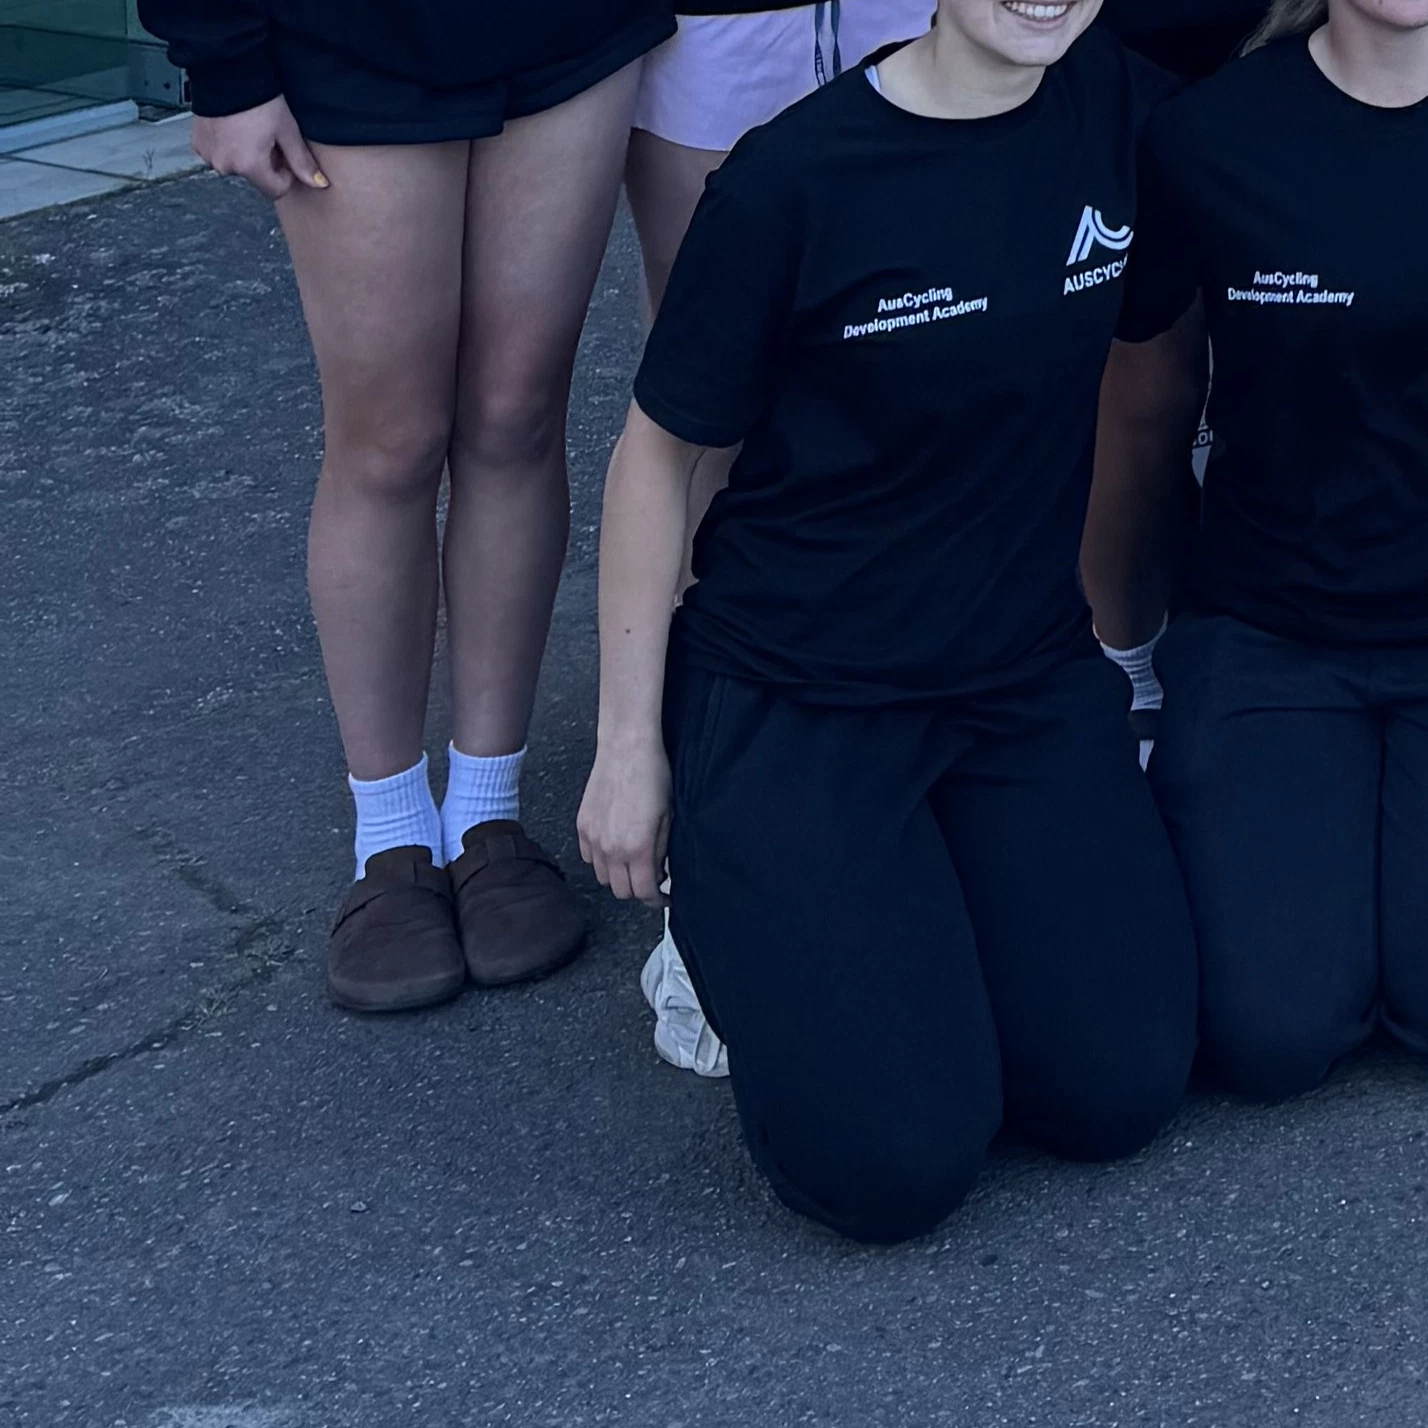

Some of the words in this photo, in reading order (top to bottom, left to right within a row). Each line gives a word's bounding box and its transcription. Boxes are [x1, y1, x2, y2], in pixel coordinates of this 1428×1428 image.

[877, 286, 953, 313] AusCycling
[1295, 289, 1355, 307] Academy
[843, 309, 931, 339] Development
[931, 296, 989, 322] Academy
